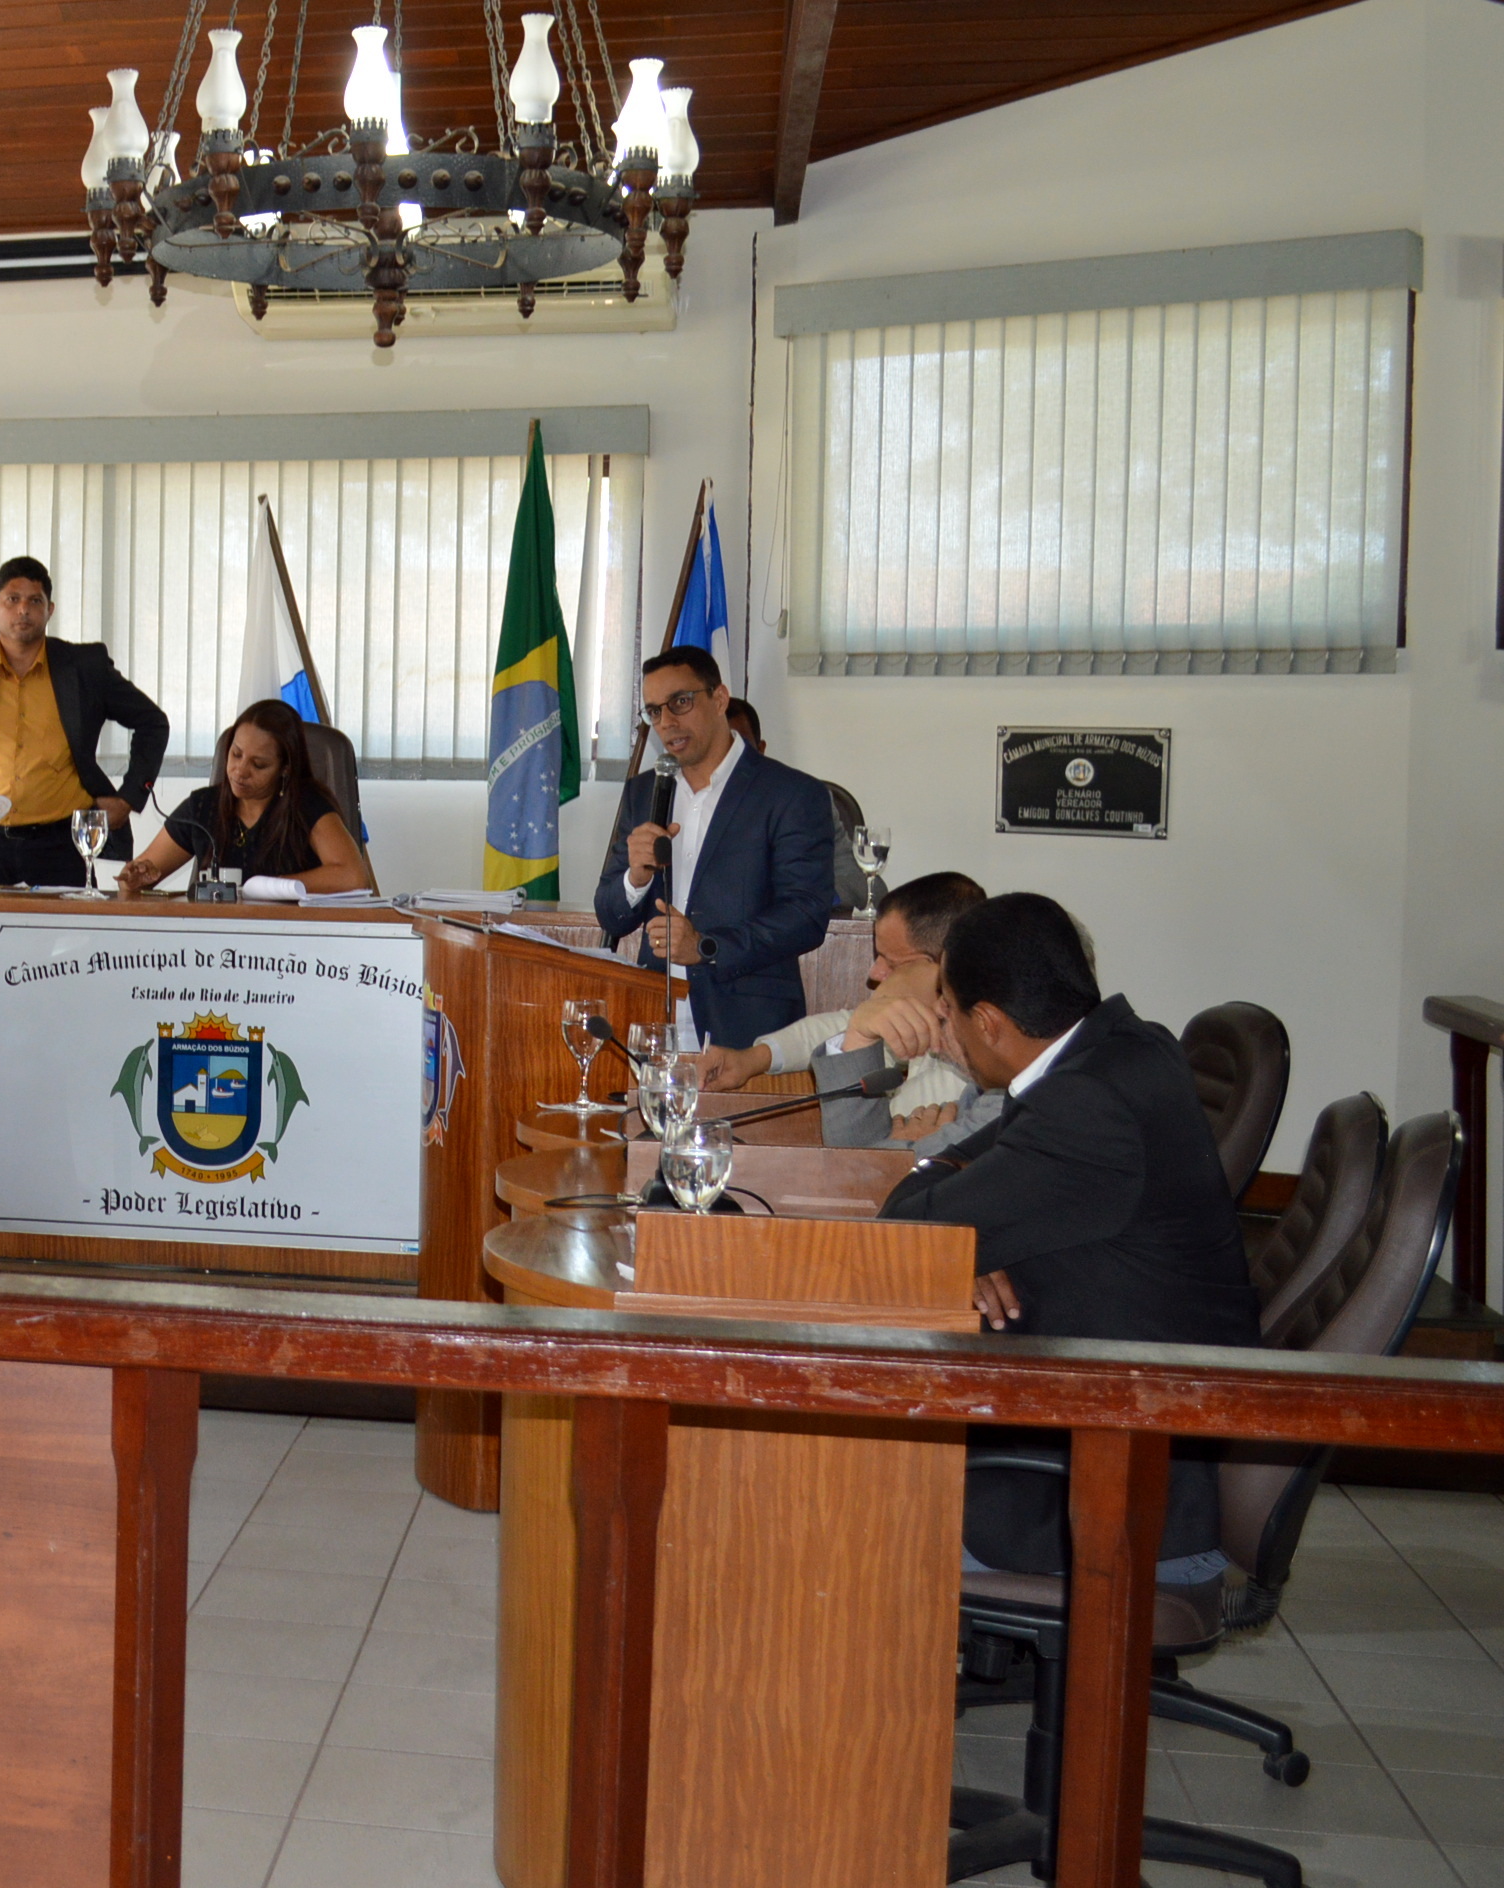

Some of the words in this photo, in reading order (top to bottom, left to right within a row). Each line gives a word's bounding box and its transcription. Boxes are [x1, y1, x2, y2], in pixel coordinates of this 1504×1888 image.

[1033, 733, 1073, 752] MUNICIPAL
[1073, 733, 1084, 745] DE
[1120, 739, 1136, 756] DOS
[1056, 788, 1102, 799] PLENÁRIO
[1056, 798, 1103, 809] VEREADOR
[1104, 809, 1144, 823] COUTINHO
[4, 959, 80, 986] Câmara
[87, 948, 187, 975] Municipal
[194, 948, 215, 968] de
[220, 948, 307, 979] Armação
[315, 958, 350, 981] dos
[131, 986, 175, 1001] Estado
[179, 987, 196, 1001] do
[200, 988, 222, 1002] Rio
[223, 989, 240, 1003] de
[243, 990, 295, 1005] Janeiro
[172, 1043, 207, 1053] ARMAÇÃO
[208, 1044, 223, 1052] DOS
[224, 1044, 250, 1054] BÚZIOS
[181, 1167, 204, 1180] 1740
[215, 1169, 239, 1180] 1995
[100, 1188, 167, 1215] Poder
[175, 1191, 302, 1221] Legislativo
